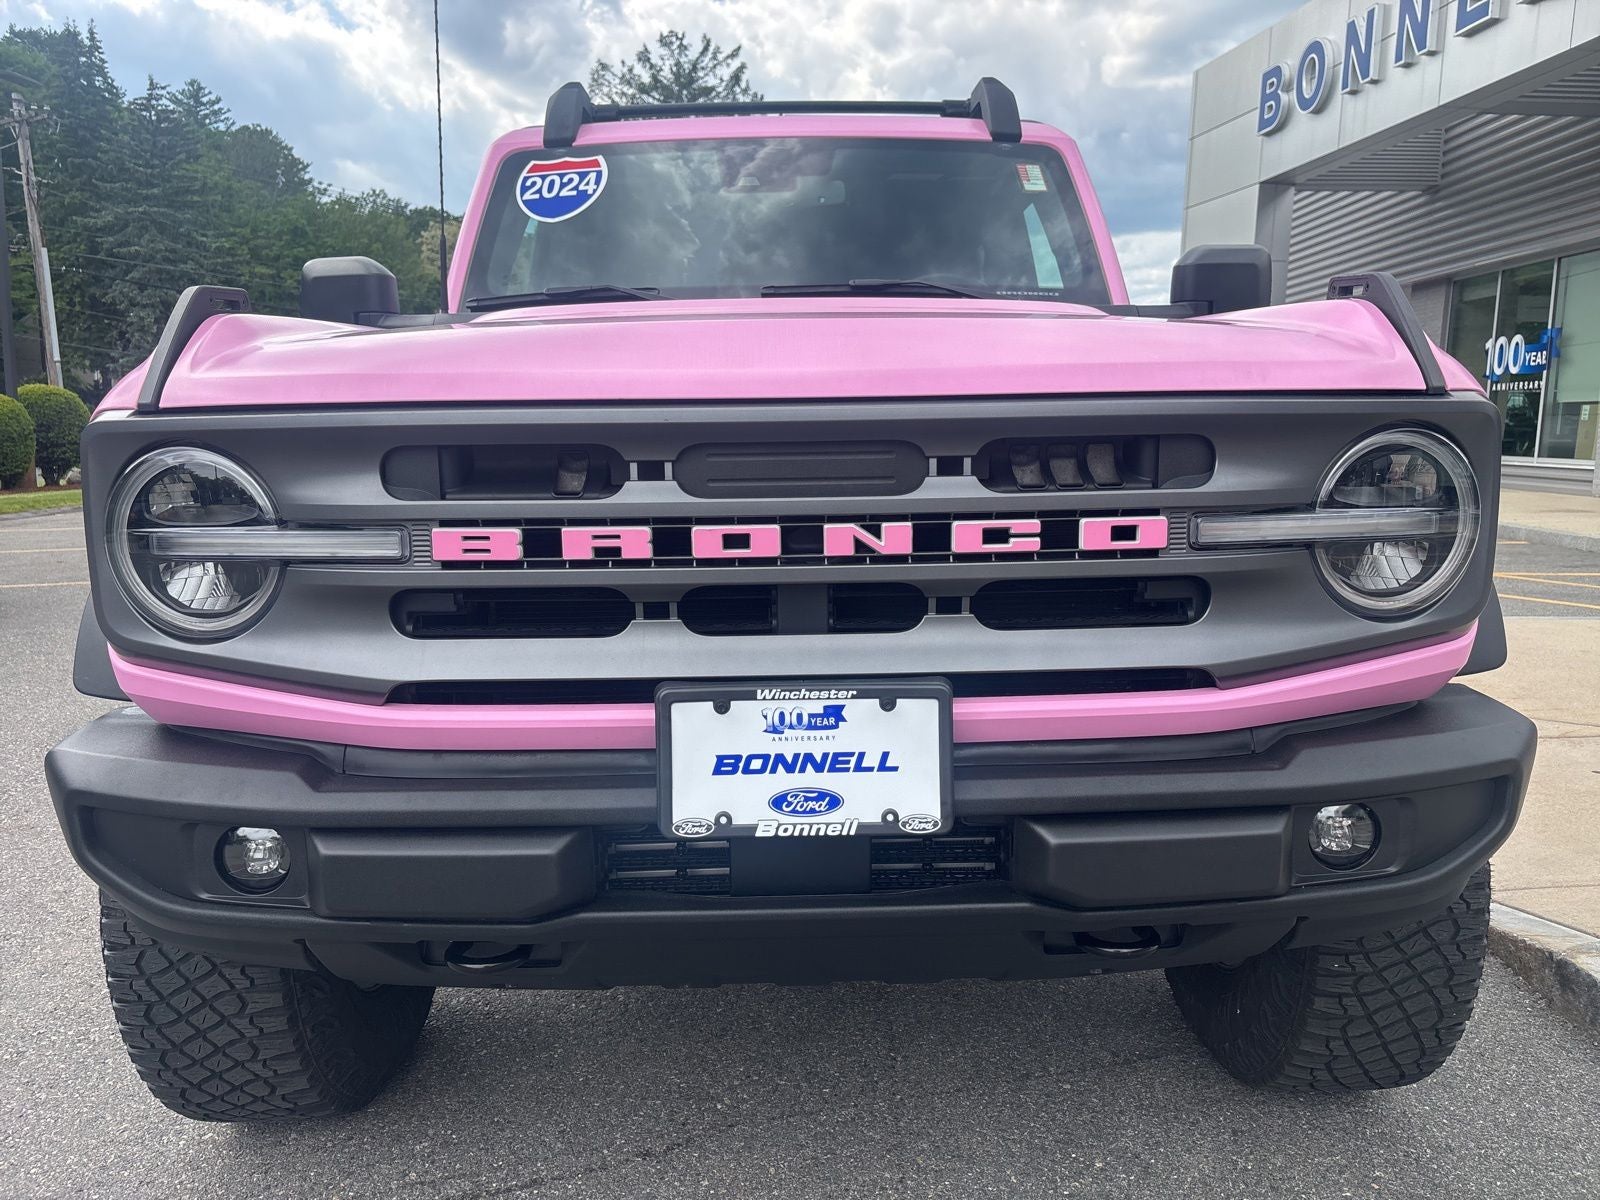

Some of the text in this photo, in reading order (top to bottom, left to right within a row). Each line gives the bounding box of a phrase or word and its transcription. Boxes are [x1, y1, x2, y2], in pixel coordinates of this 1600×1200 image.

[522, 172, 597, 200] 2024
[1485, 334, 1525, 376] 100
[430, 515, 1169, 562] BRONCO
[757, 689, 857, 700] Winchester
[761, 706, 836, 732] 100 YEAR
[711, 751, 899, 776] BONNELL
[782, 792, 829, 812] Ford
[679, 822, 708, 834] Ford
[755, 818, 859, 838] Bonnell
[905, 818, 935, 830] Ford
